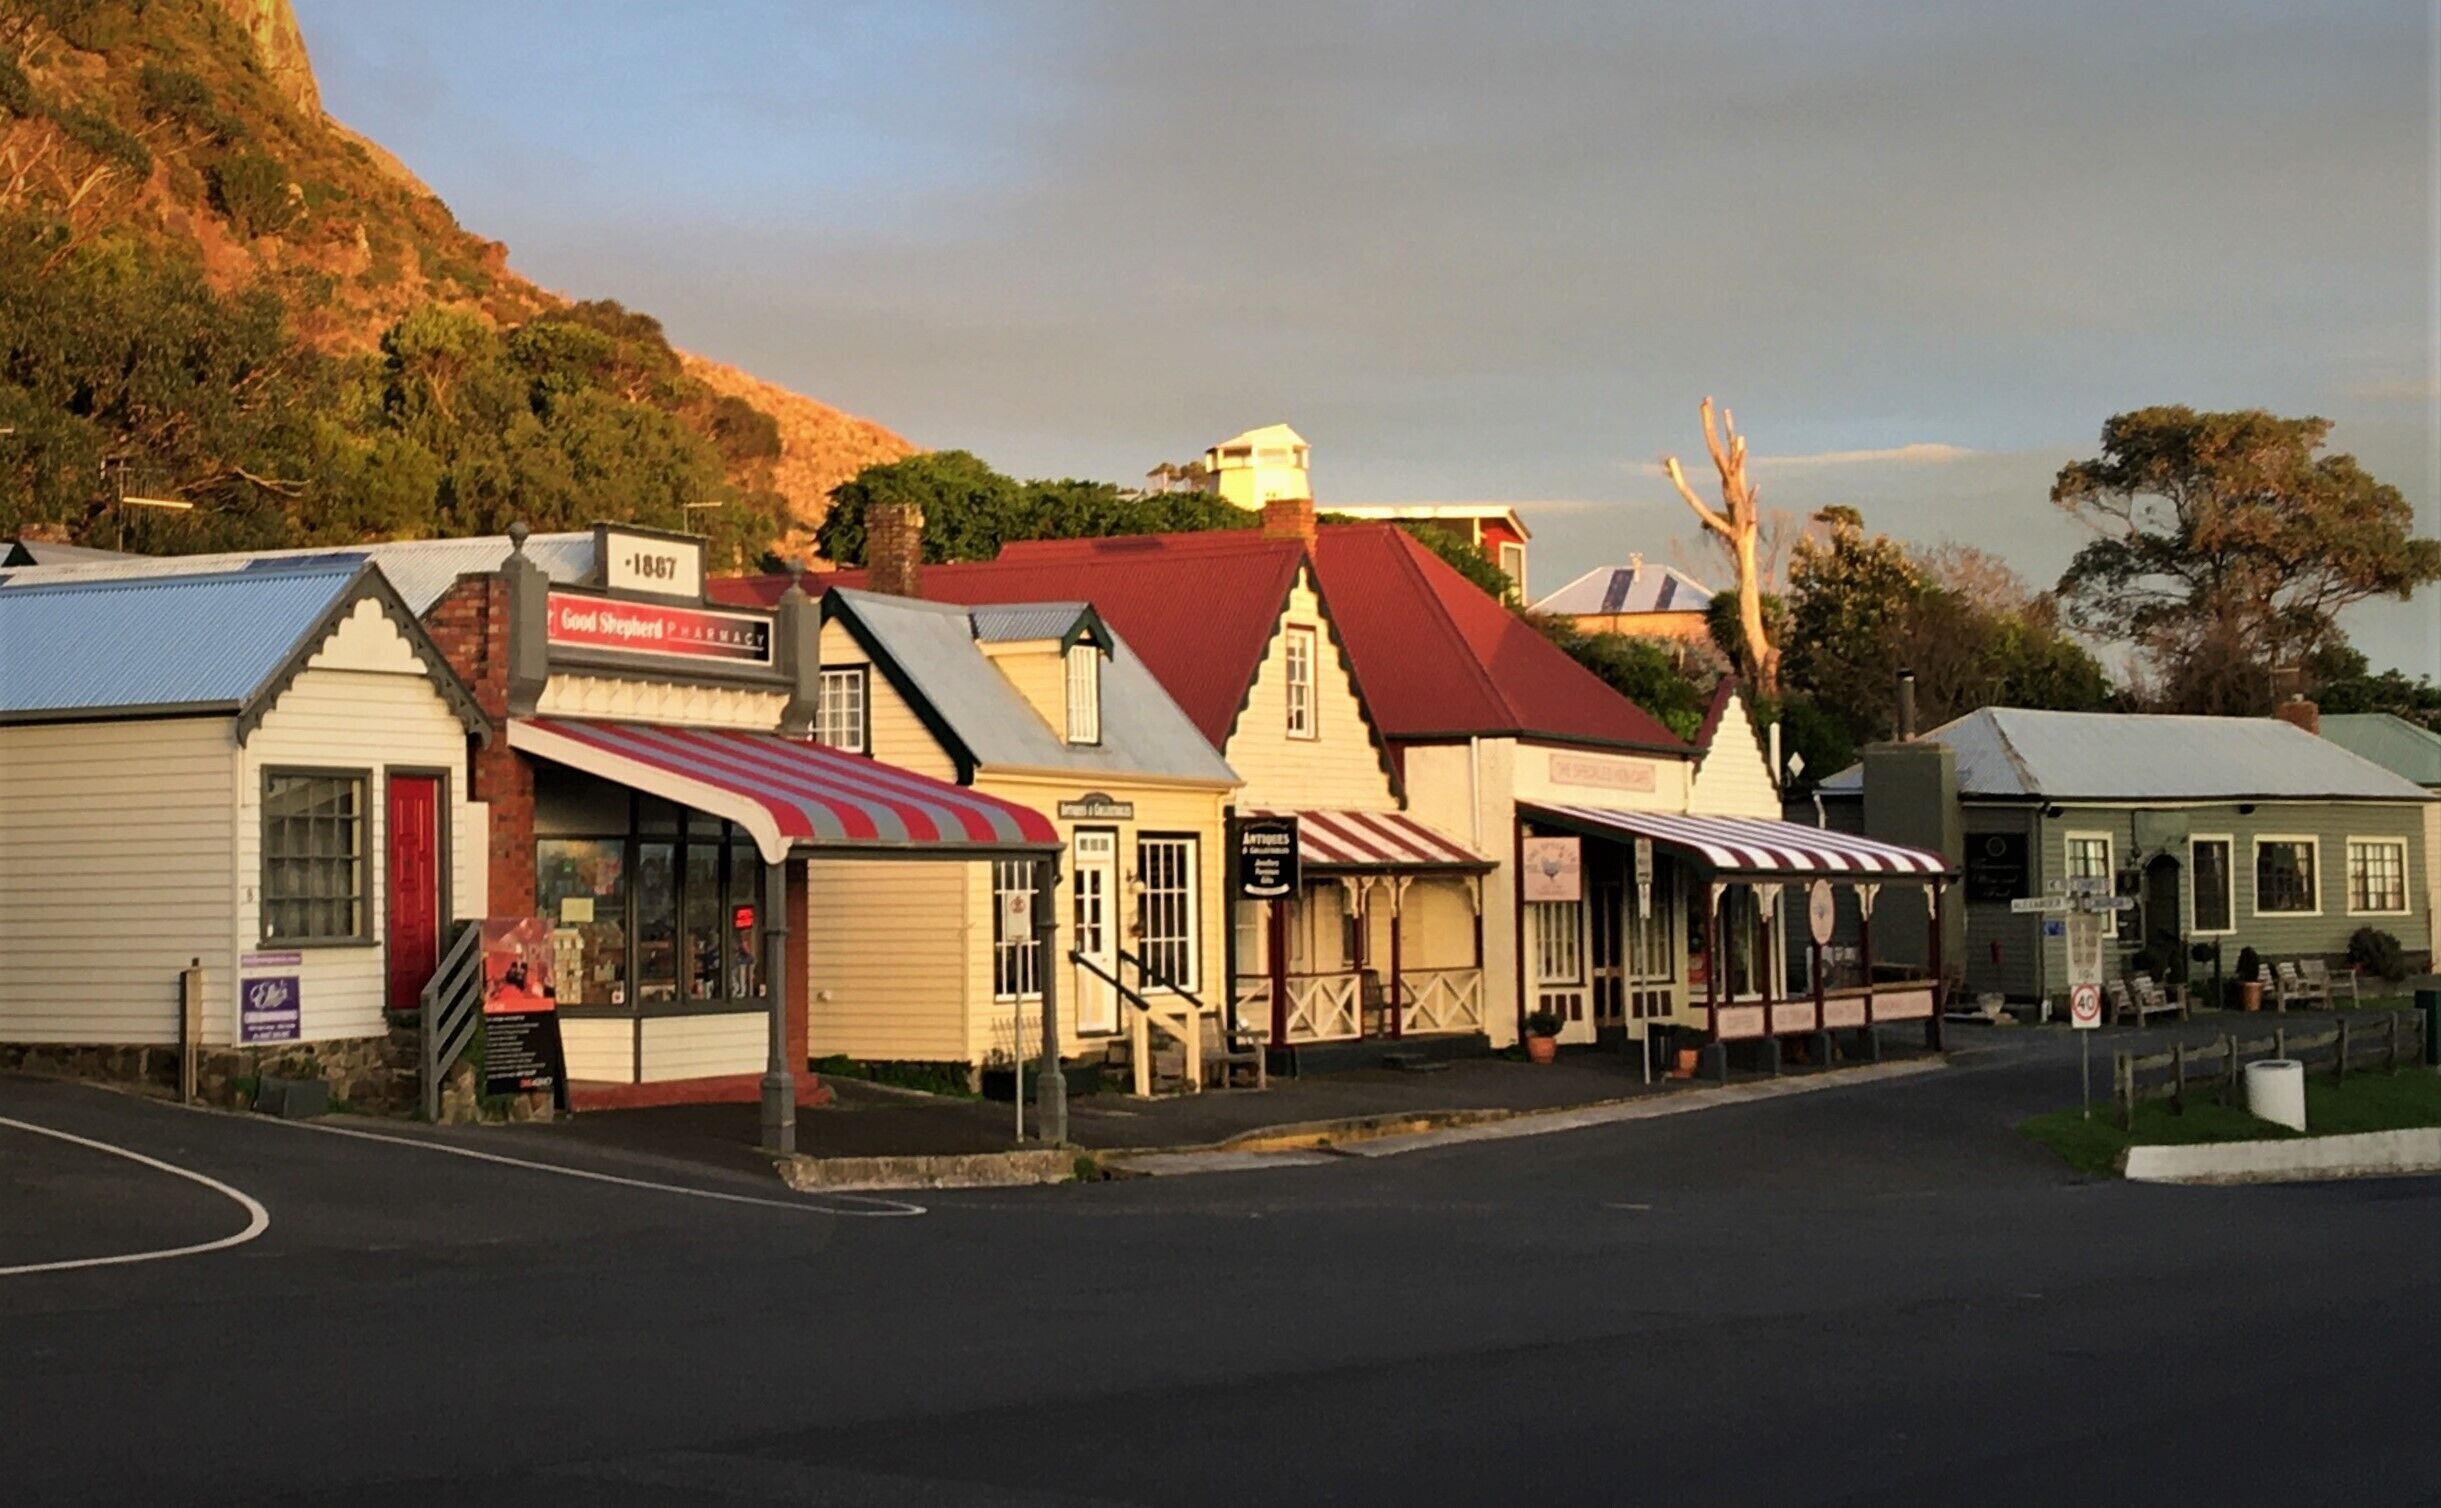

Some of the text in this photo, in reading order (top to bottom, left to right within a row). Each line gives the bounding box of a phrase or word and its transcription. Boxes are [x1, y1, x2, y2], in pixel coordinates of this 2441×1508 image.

[634, 553, 676, 580] 1887
[561, 607, 765, 646] Good Shepherd PHARMACY
[2077, 995, 2096, 1011] 40
